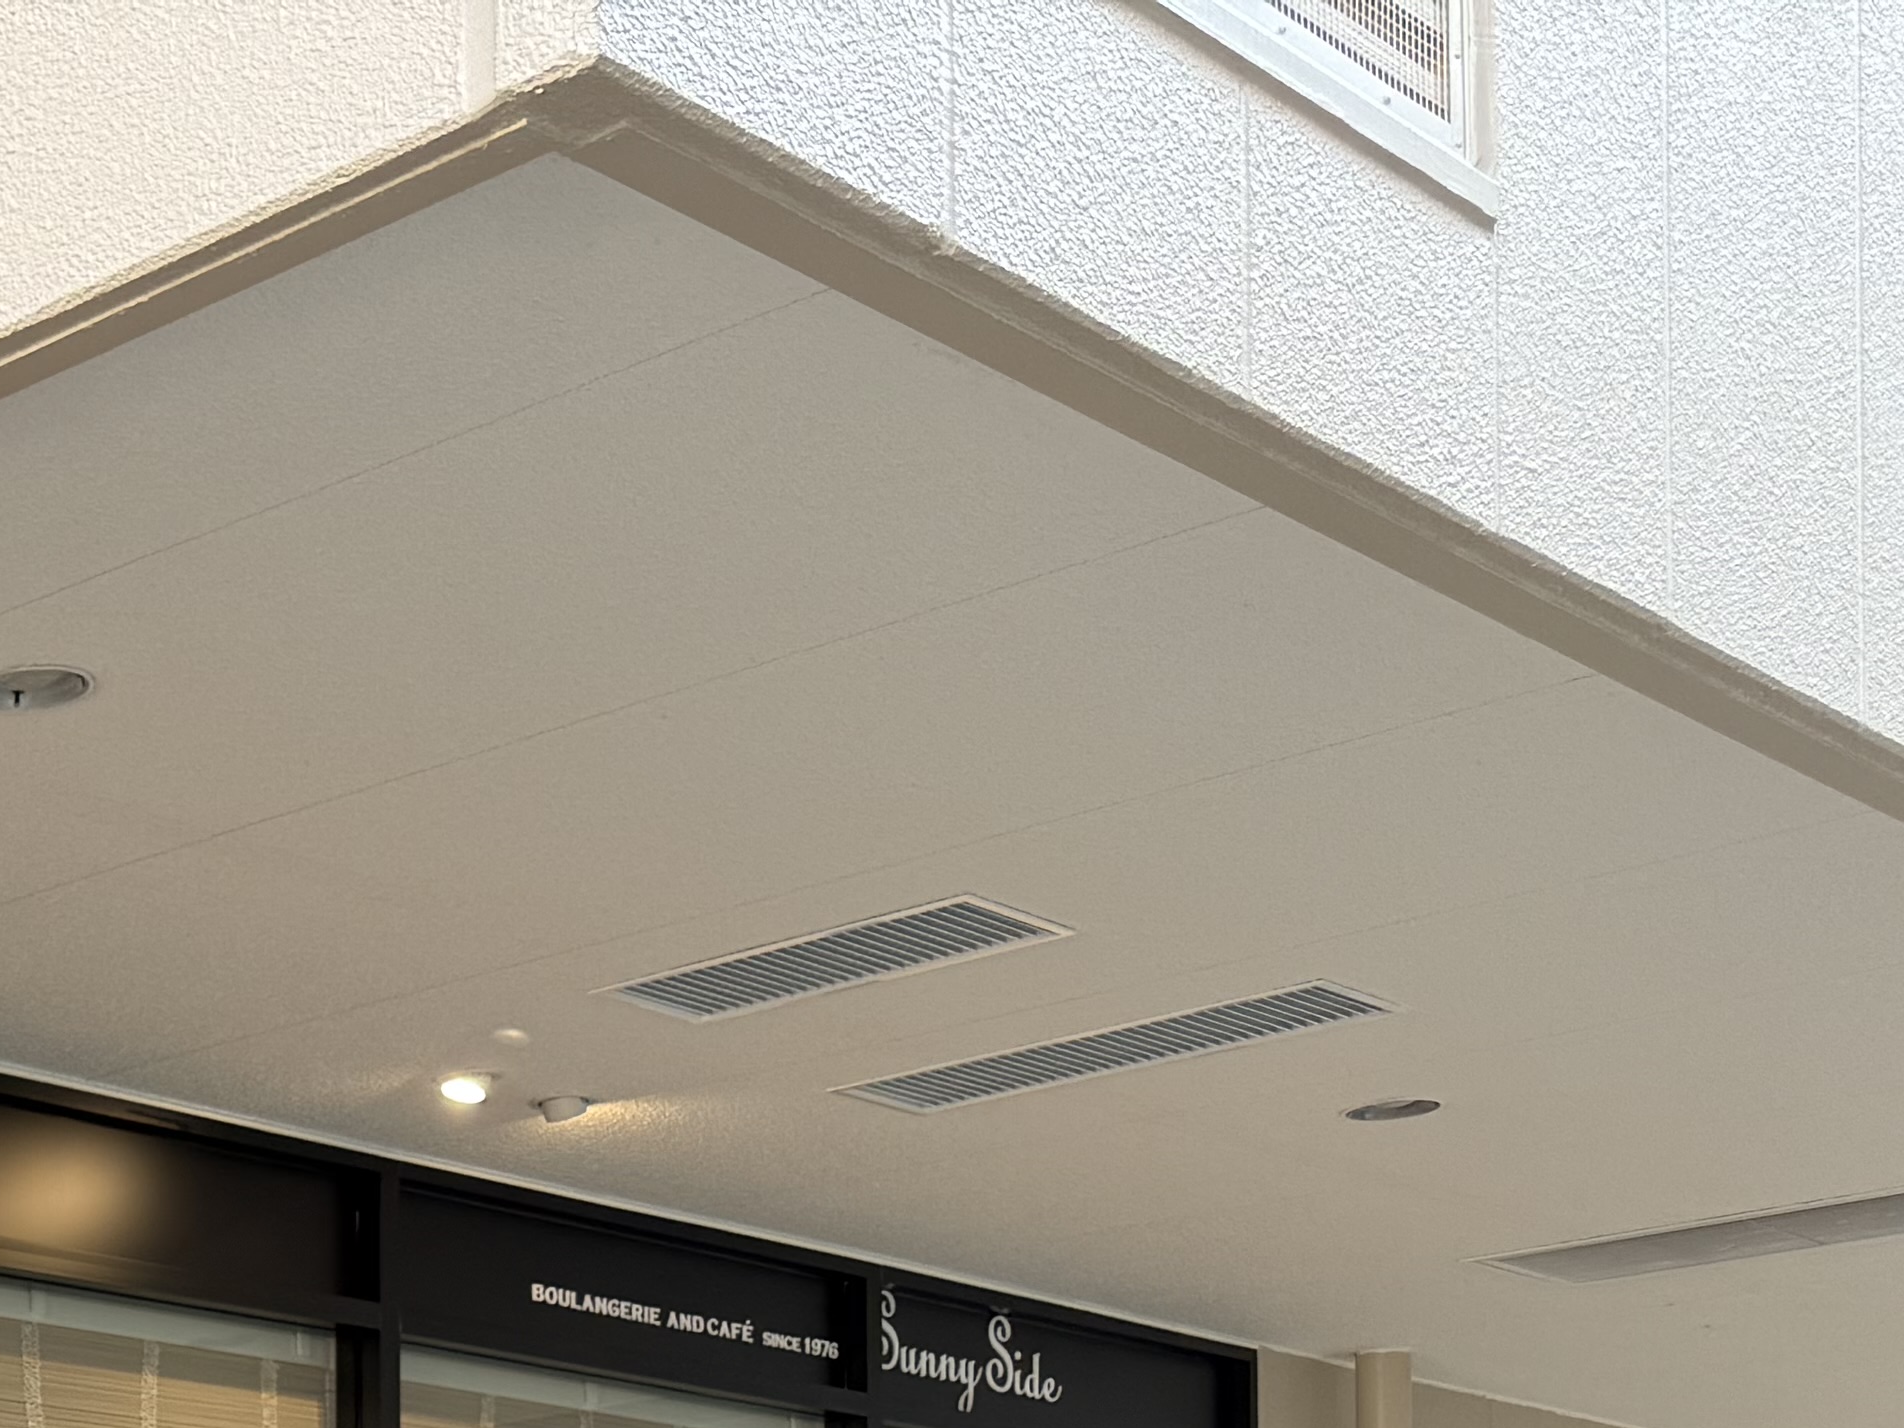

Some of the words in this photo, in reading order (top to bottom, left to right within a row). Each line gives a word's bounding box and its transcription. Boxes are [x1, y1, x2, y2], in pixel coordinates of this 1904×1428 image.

[531, 1283, 661, 1326] BOULANGERIE
[666, 1311, 704, 1333] AND
[706, 1319, 754, 1343] CAFÉ
[762, 1331, 801, 1353] SINCE
[804, 1337, 839, 1360] 1976
[985, 1315, 1062, 1403] Side
